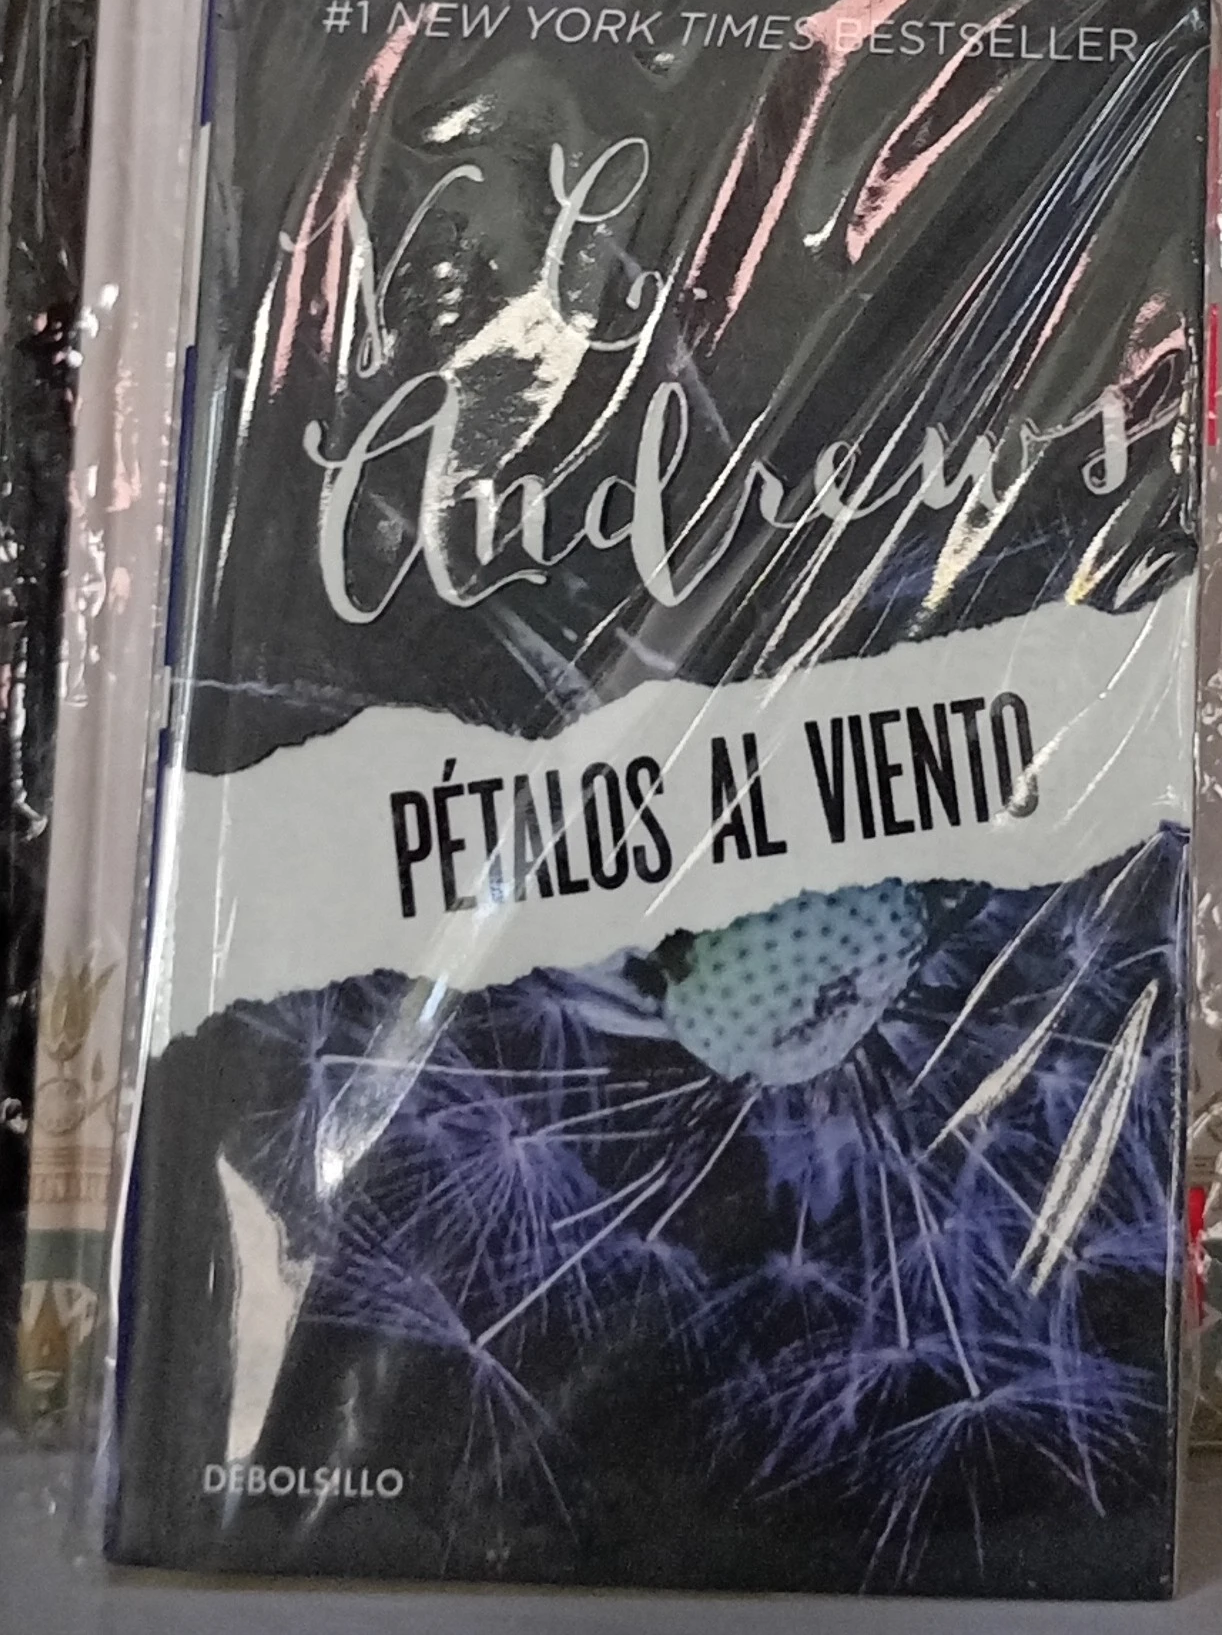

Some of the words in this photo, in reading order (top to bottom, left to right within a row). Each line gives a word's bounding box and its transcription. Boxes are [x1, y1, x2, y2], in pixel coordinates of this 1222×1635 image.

[322, 0, 371, 35] #1
[386, 2, 511, 39] NEW
[526, 6, 663, 46] YORK
[680, 11, 818, 53] TIMES
[834, 18, 1140, 64] BESTSELLER
[302, 349, 1188, 625] Andrews
[388, 754, 674, 919] PÉTALOS
[709, 732, 788, 865] AL
[802, 691, 1041, 844] VIENTO
[202, 1464, 404, 1499] DEBOLSILLO
